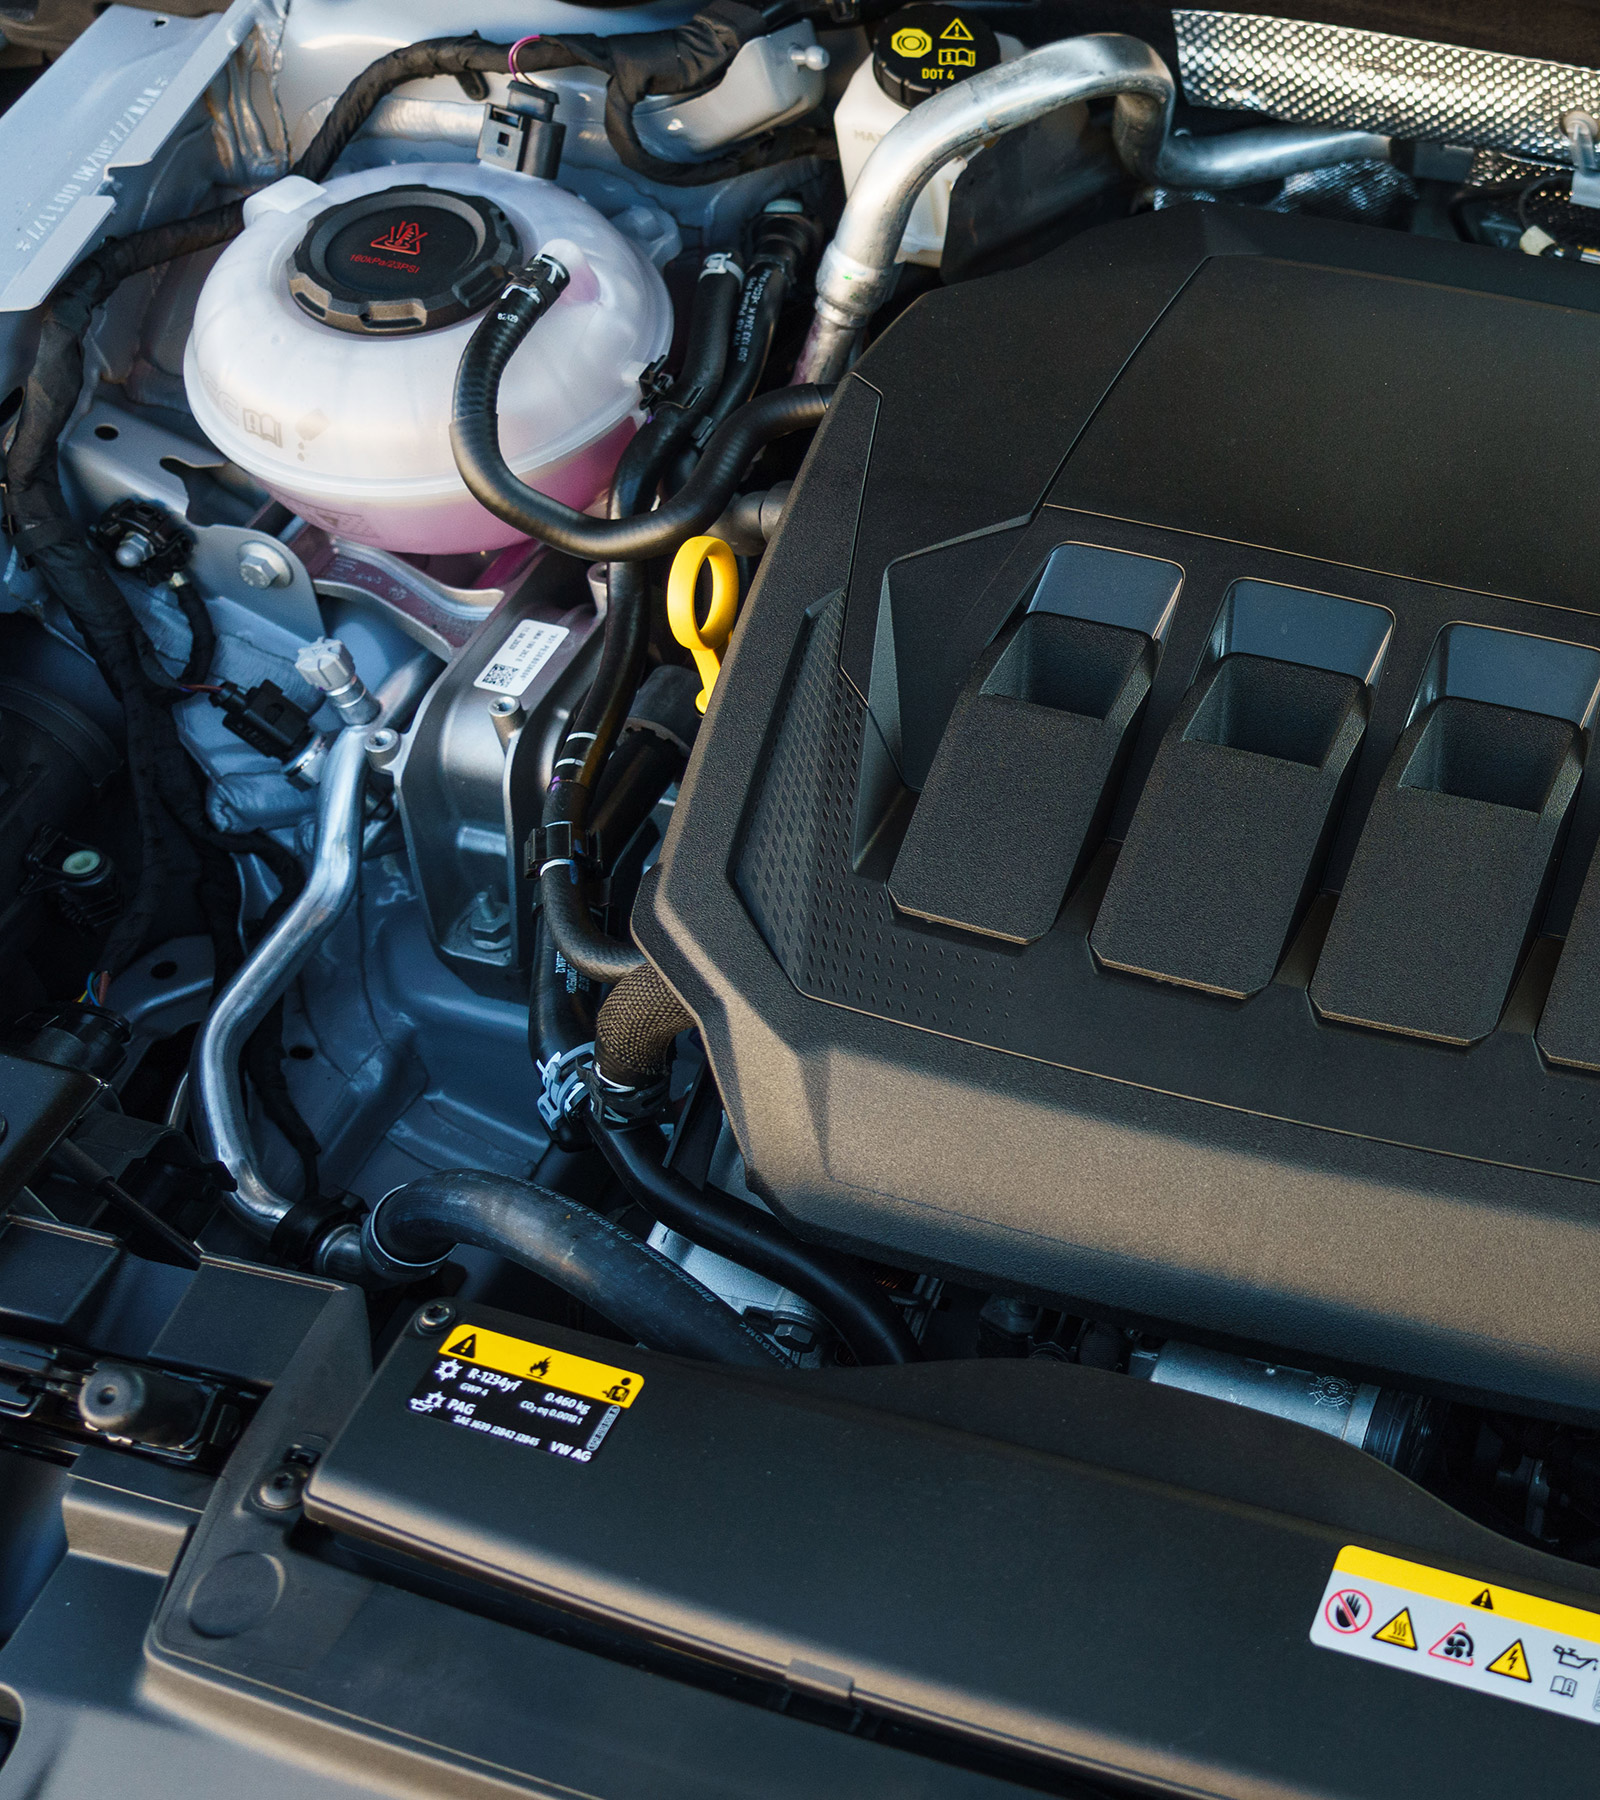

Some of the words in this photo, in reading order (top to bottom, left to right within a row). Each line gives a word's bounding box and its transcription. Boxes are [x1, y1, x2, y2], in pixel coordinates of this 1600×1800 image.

[921, 67, 944, 80] DOT
[947, 68, 955, 81] 4
[350, 253, 420, 275] 160kPa/23PSI
[459, 1382, 482, 1394] GWP
[482, 1387, 490, 1397] 4
[467, 1367, 523, 1392] R-1234yf
[447, 1397, 477, 1416] PAG
[543, 1392, 577, 1410] 0.460
[576, 1399, 592, 1415] kg
[452, 1413, 470, 1427] SAE
[549, 1440, 573, 1457] VW
[570, 1446, 593, 1463] AG
